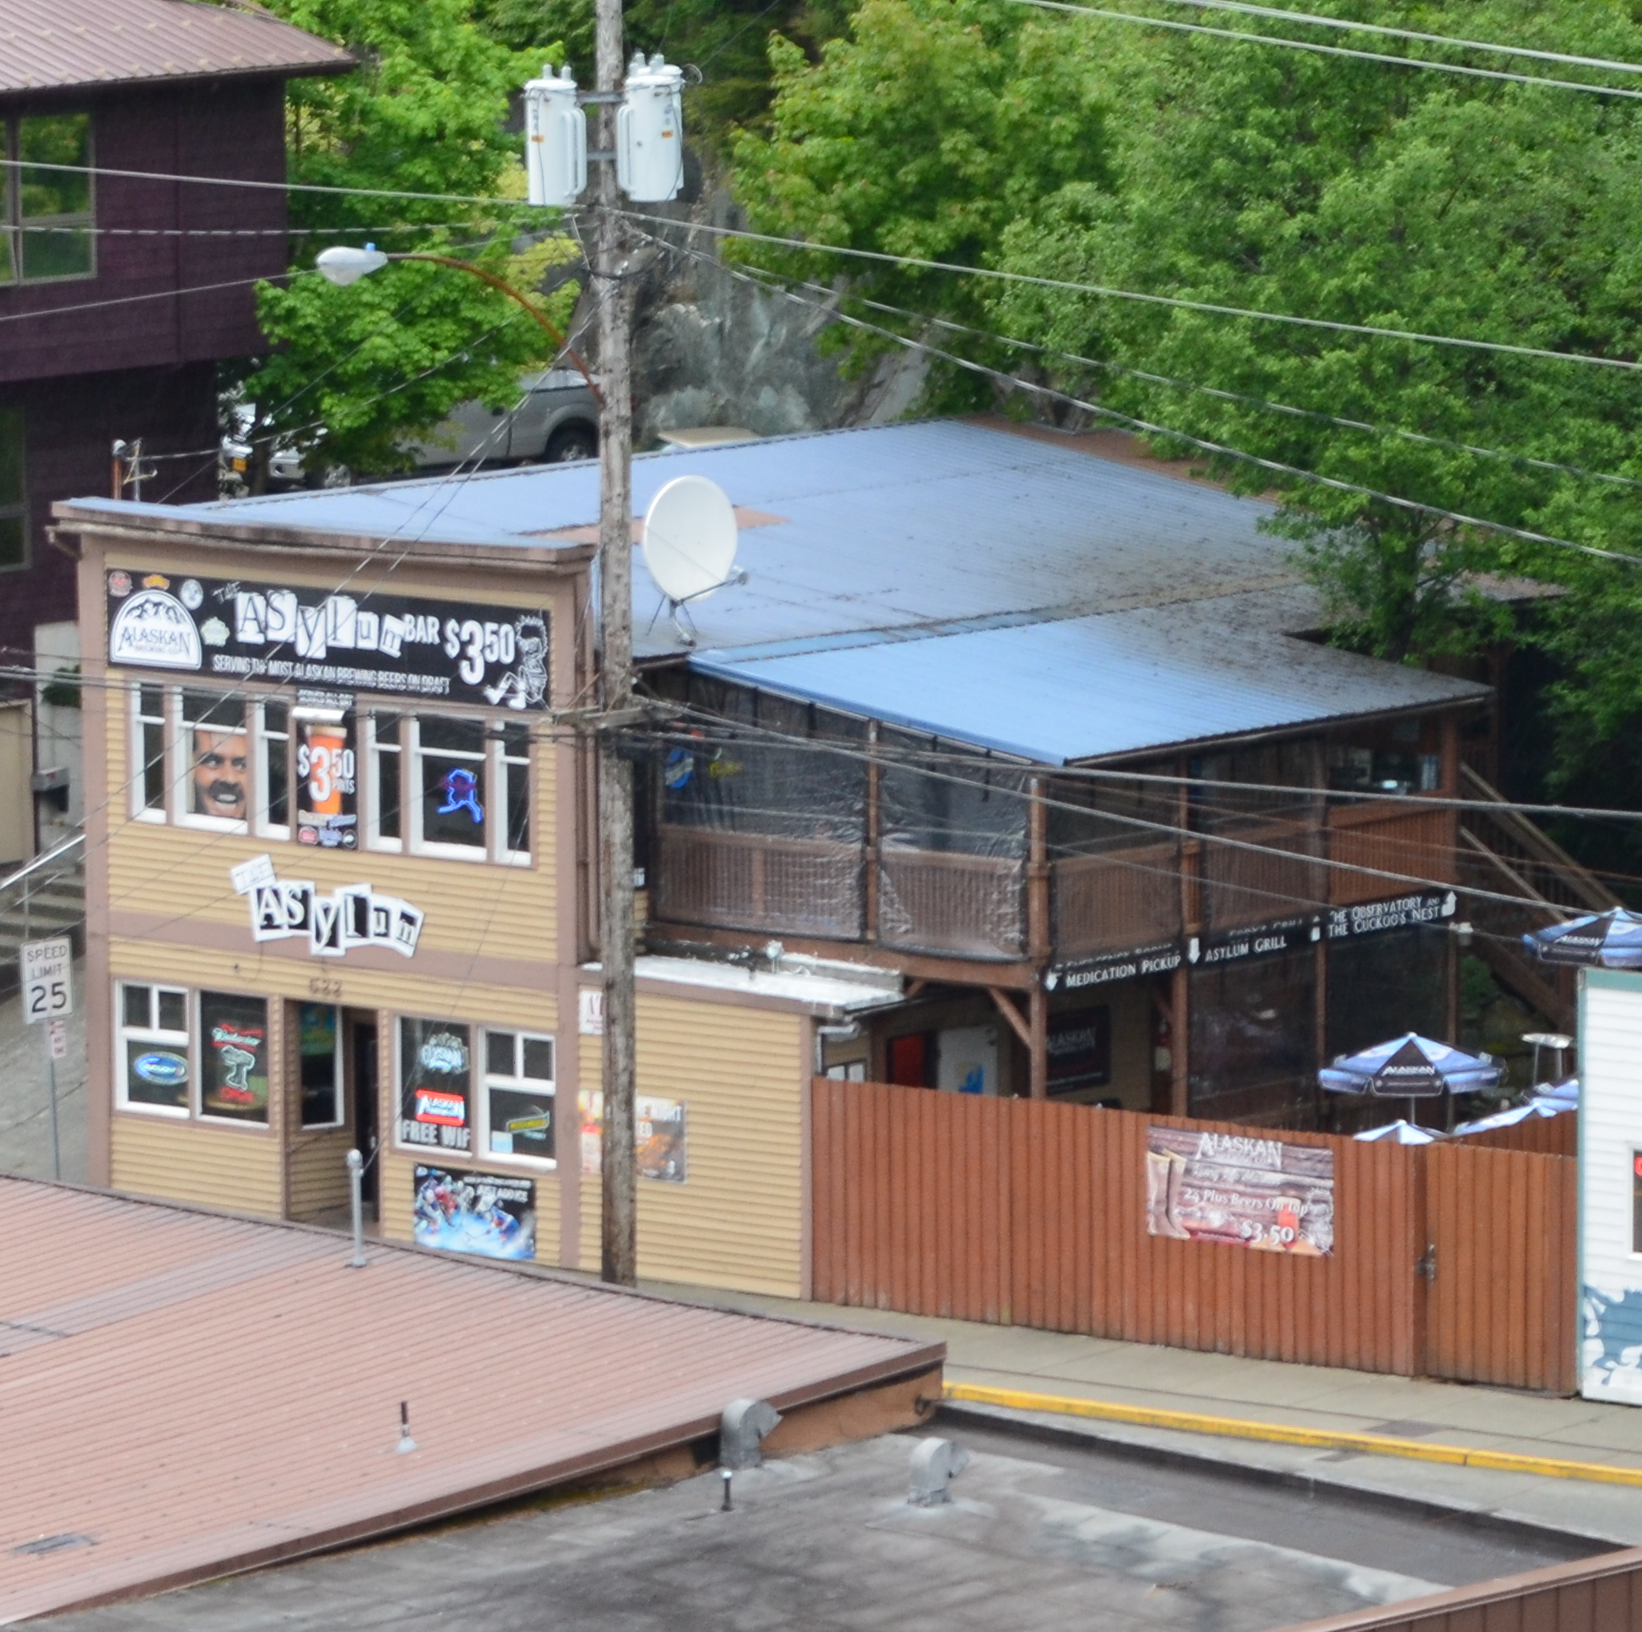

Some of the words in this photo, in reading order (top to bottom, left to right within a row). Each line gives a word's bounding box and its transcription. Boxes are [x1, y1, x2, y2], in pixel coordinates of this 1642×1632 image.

[118, 626, 191, 656] ALASKAN
[404, 613, 441, 645] BAR
[212, 654, 251, 673] SERVING
[268, 660, 294, 677] MOST
[1351, 896, 1422, 920] OBSERVATORY
[1329, 923, 1348, 938] THE
[1411, 906, 1439, 922] NEST
[27, 945, 67, 962] SPEED
[1205, 942, 1249, 962] ASYLUM
[1254, 935, 1287, 953] GRILL
[32, 963, 62, 979] LIMIT
[1065, 964, 1136, 988] MEDICATION
[1141, 955, 1182, 975] PICKUP
[31, 982, 67, 1013] 25
[1381, 1065, 1436, 1076] ALASKAN
[402, 1119, 438, 1144] FREE
[1195, 1131, 1282, 1170] ALASKAN
[1184, 1188, 1200, 1202] 24
[1204, 1189, 1227, 1203] Plus
[1231, 1193, 1263, 1209] Beers
[1240, 1220, 1294, 1246] $3.50
